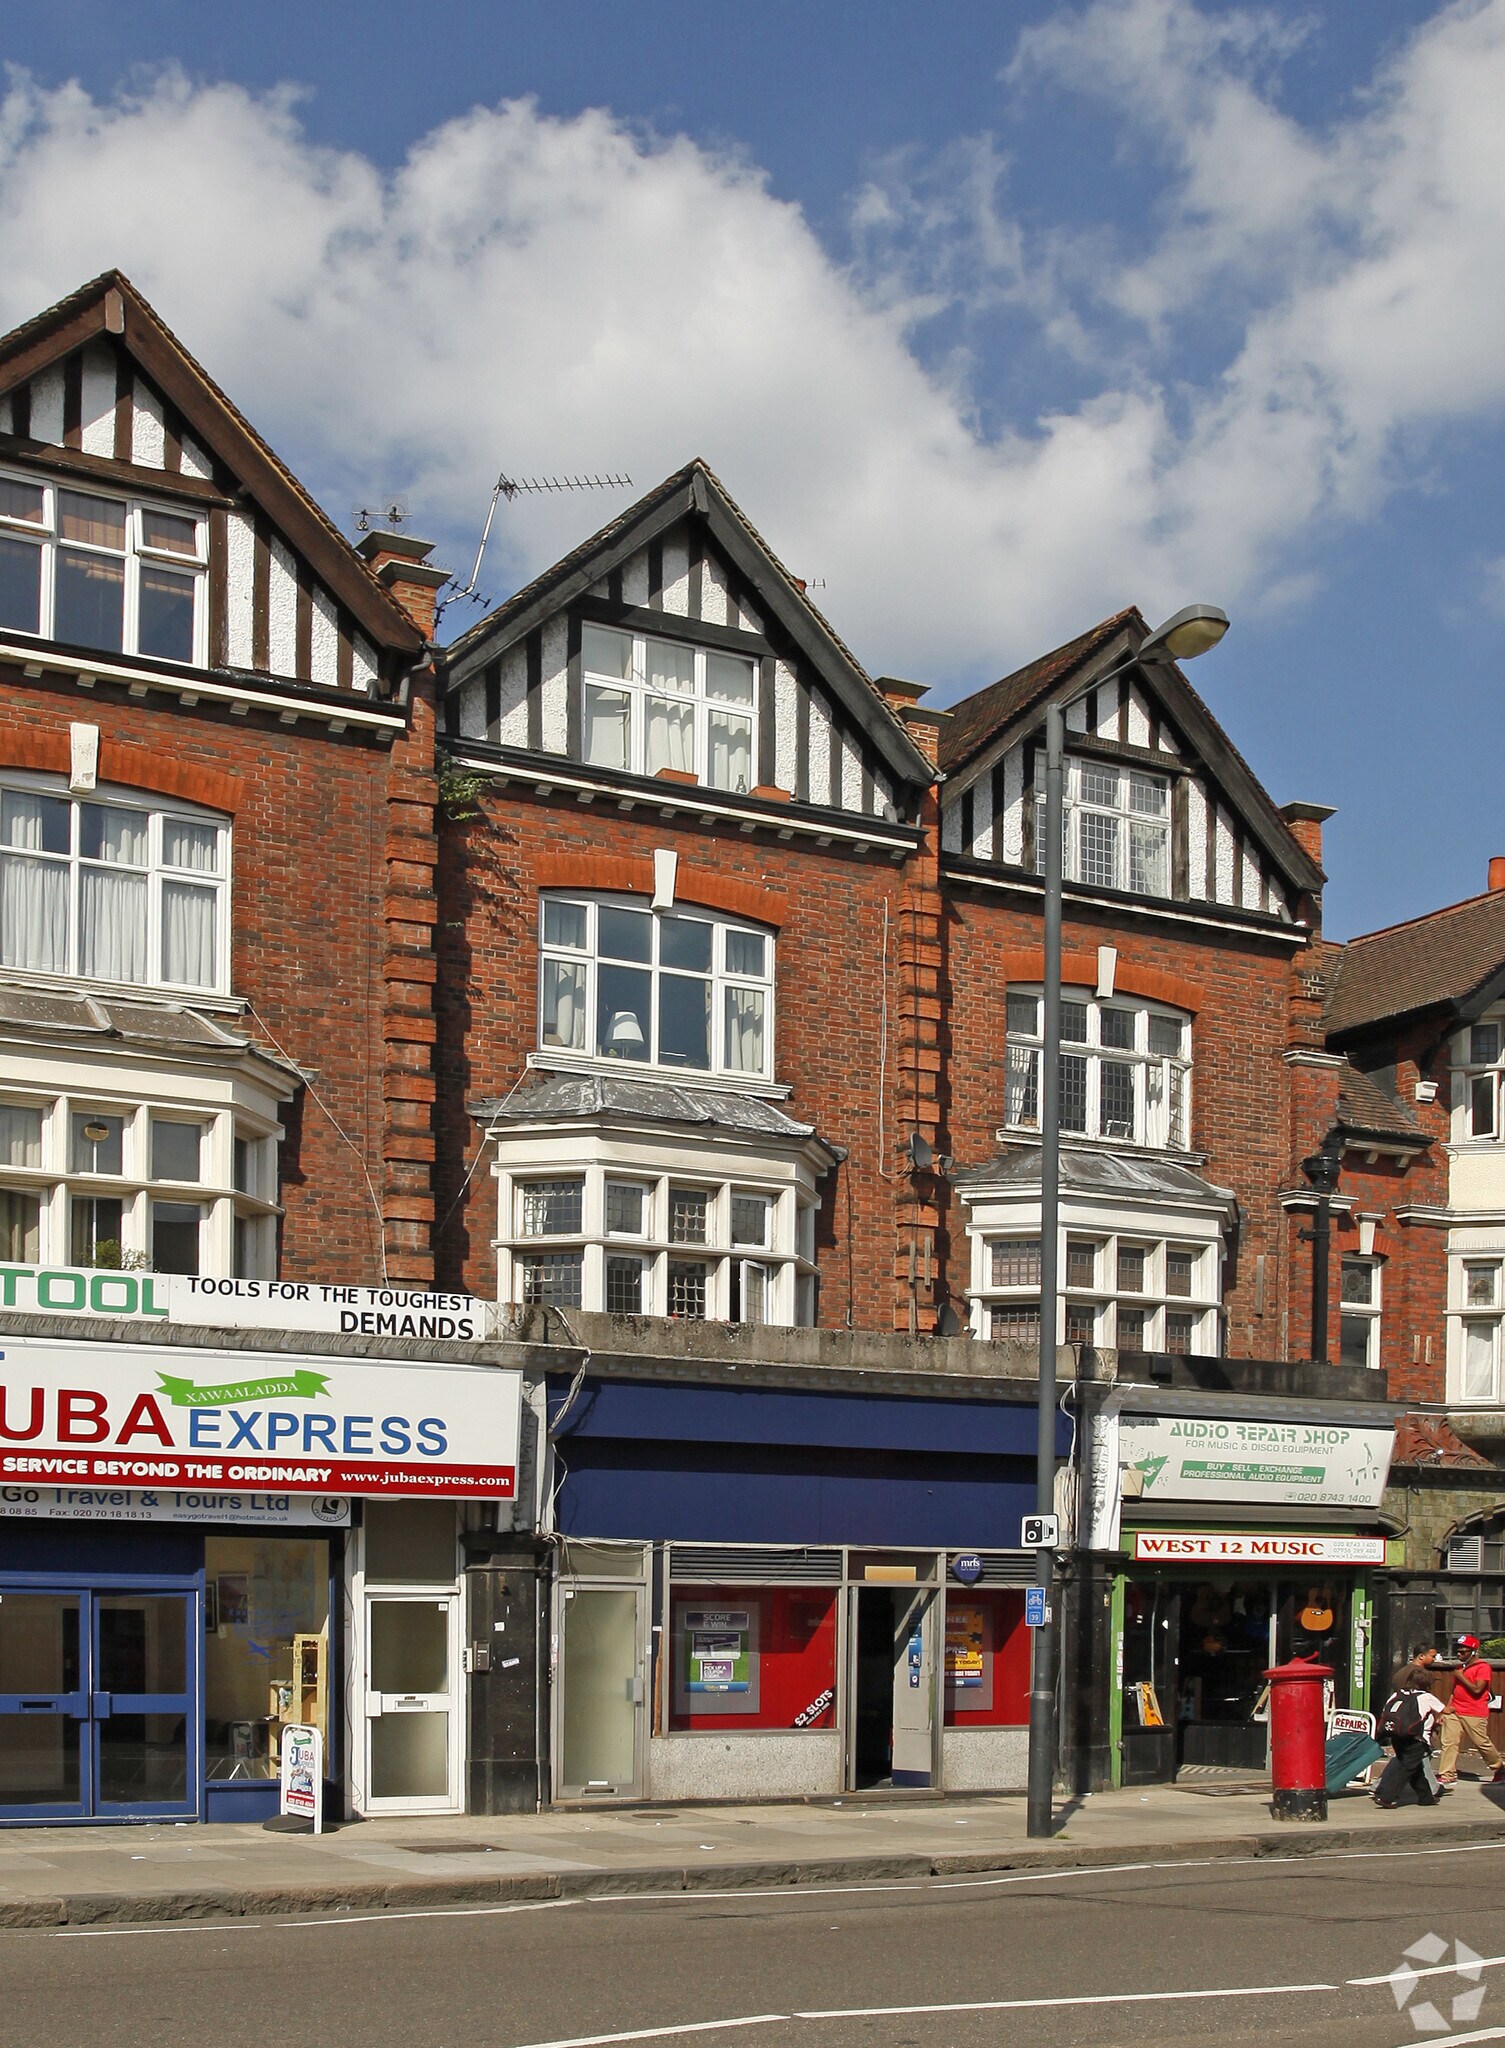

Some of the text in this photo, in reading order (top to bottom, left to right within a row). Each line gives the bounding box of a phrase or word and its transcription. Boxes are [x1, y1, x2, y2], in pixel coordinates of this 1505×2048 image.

[187, 1277, 474, 1312] TOOLS FOR THE TOUGHEST
[340, 1311, 474, 1340] DEMANDS
[186, 1382, 298, 1403] XAWAALADDA
[190, 1409, 448, 1456] EXPRESS
[1303, 1430, 1350, 1444] SHOP
[1185, 1440, 1335, 1454] FOR MUSIC & DISCO EQUIPMENT
[3, 1457, 510, 1486] SERVICE BEYOND THE ORDINARY www.jubaexpress.com
[1182, 1470, 1322, 1483] PROFESSIONAL AUDIO EQUIPMENT
[1232, 1464, 1251, 1472] SELL
[1259, 1465, 1304, 1474] EXCHANGE
[2, 1486, 290, 1511] Go Travel & Tours Ltd
[1297, 1493, 1372, 1503] 020 8743 1400
[95, 1510, 107, 1518] 70
[1141, 1539, 1324, 1555] WEST 12 MUSIC
[795, 1690, 833, 1726] £2 SLOTS
[1335, 1718, 1367, 1731] REPAIRS
[290, 1746, 315, 1766] JUBA
